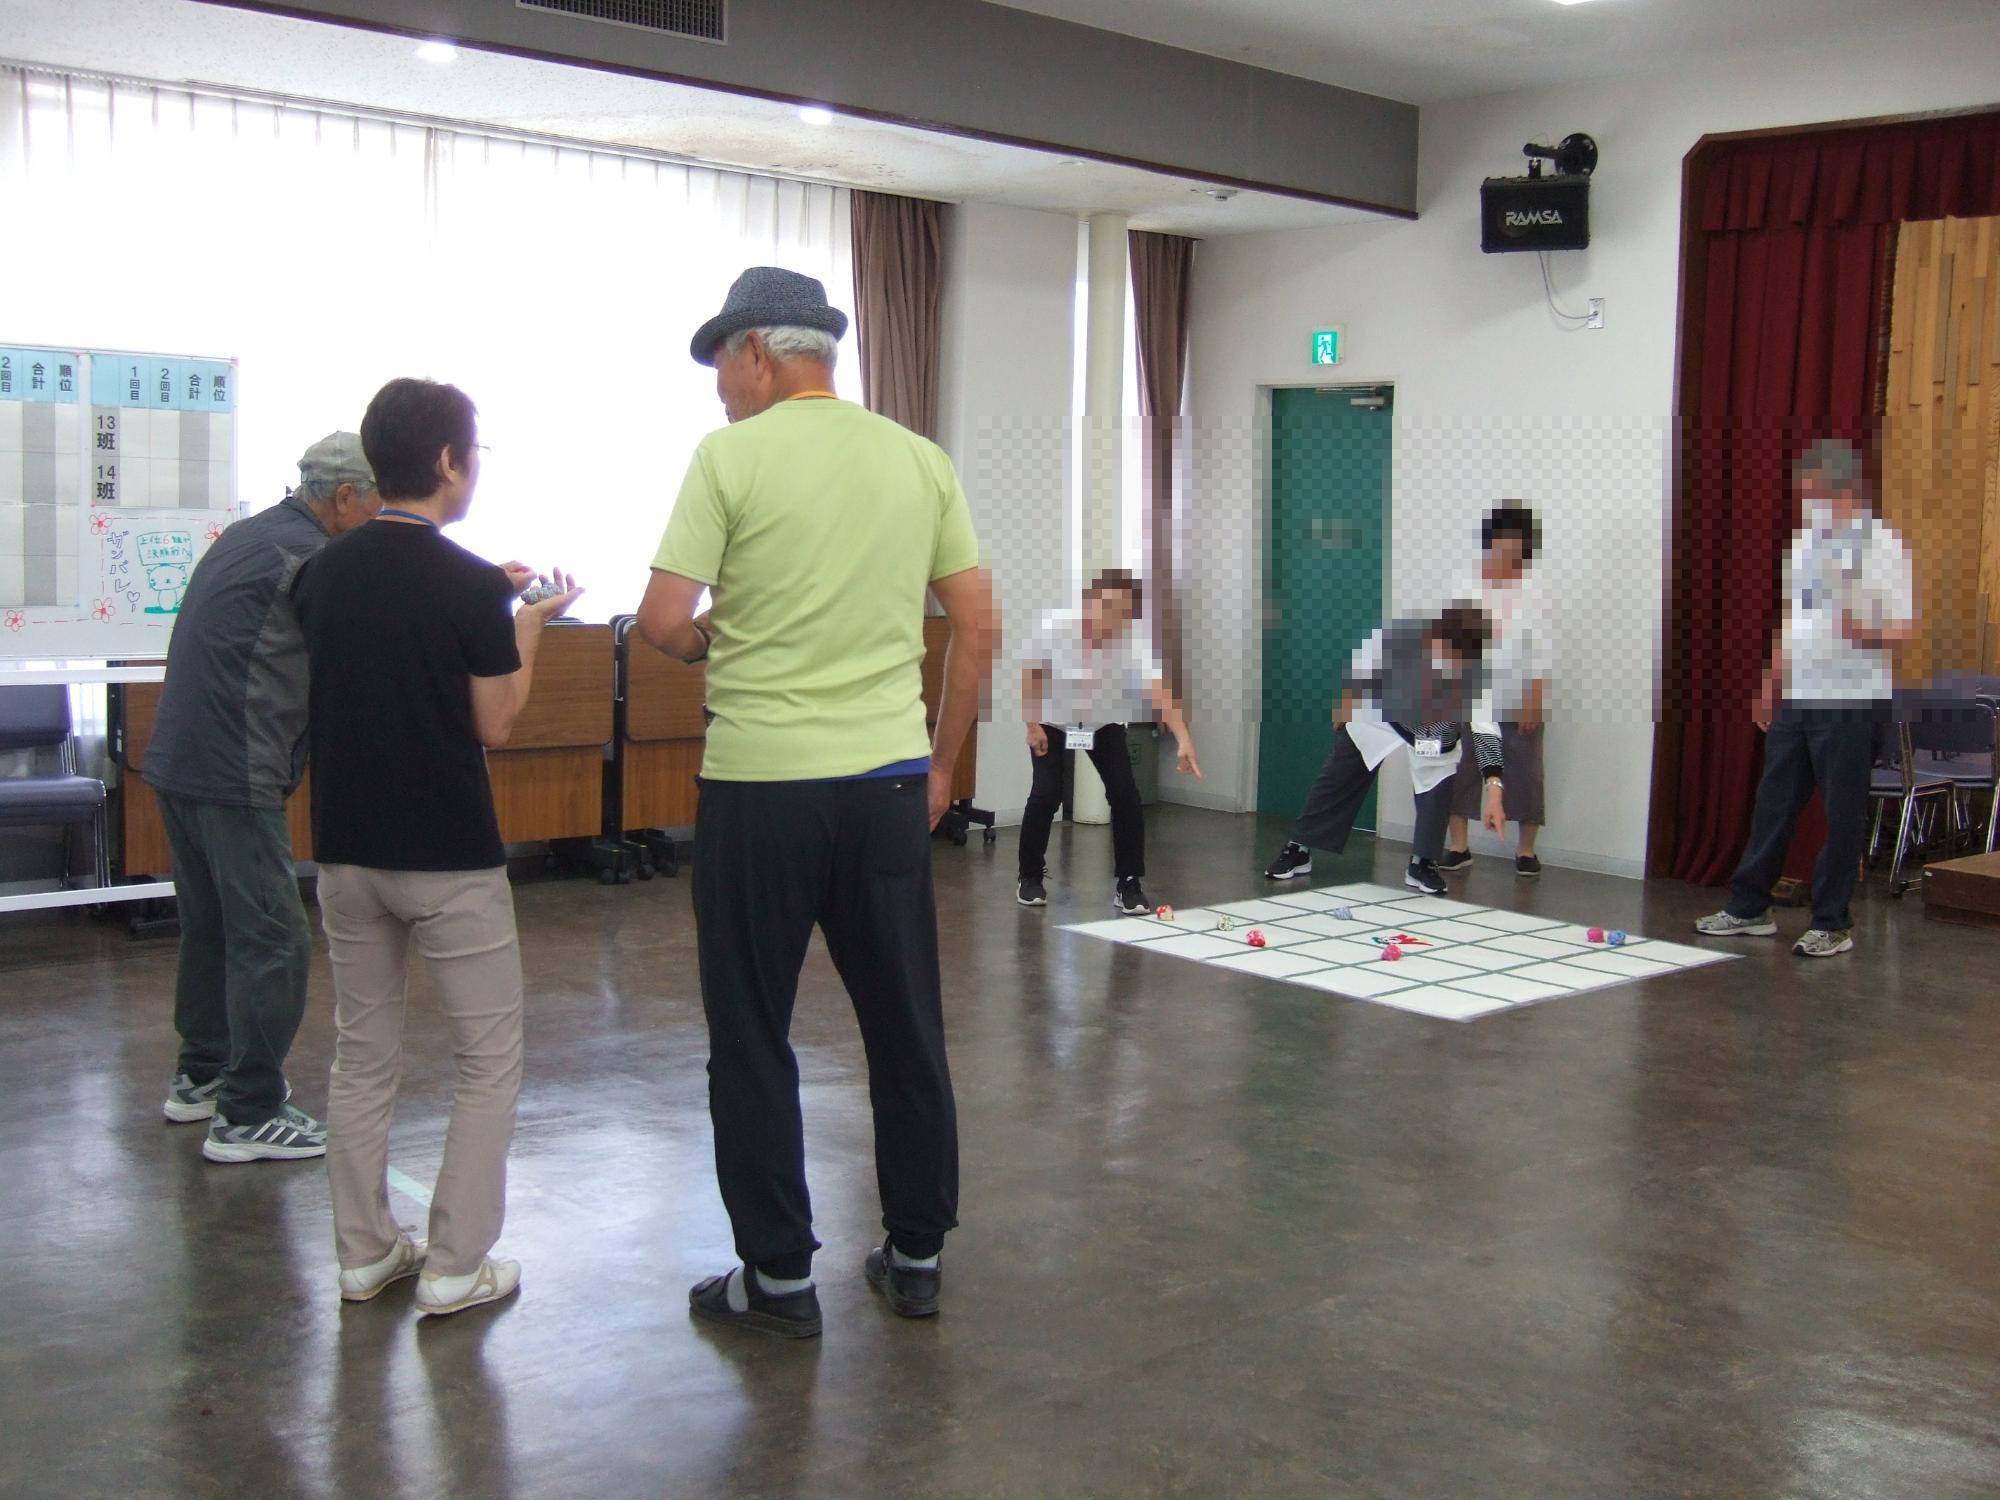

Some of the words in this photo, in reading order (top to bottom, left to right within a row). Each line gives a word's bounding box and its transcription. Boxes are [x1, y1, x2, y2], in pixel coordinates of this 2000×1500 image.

[1505, 209, 1563, 226] RAMSA
[32, 362, 46, 390] 合計
[59, 364, 73, 392] 順位
[129, 366, 141, 401] 1回目
[160, 368, 171, 402] 2回目
[188, 374, 201, 400] 合計
[213, 376, 226, 402] 順位
